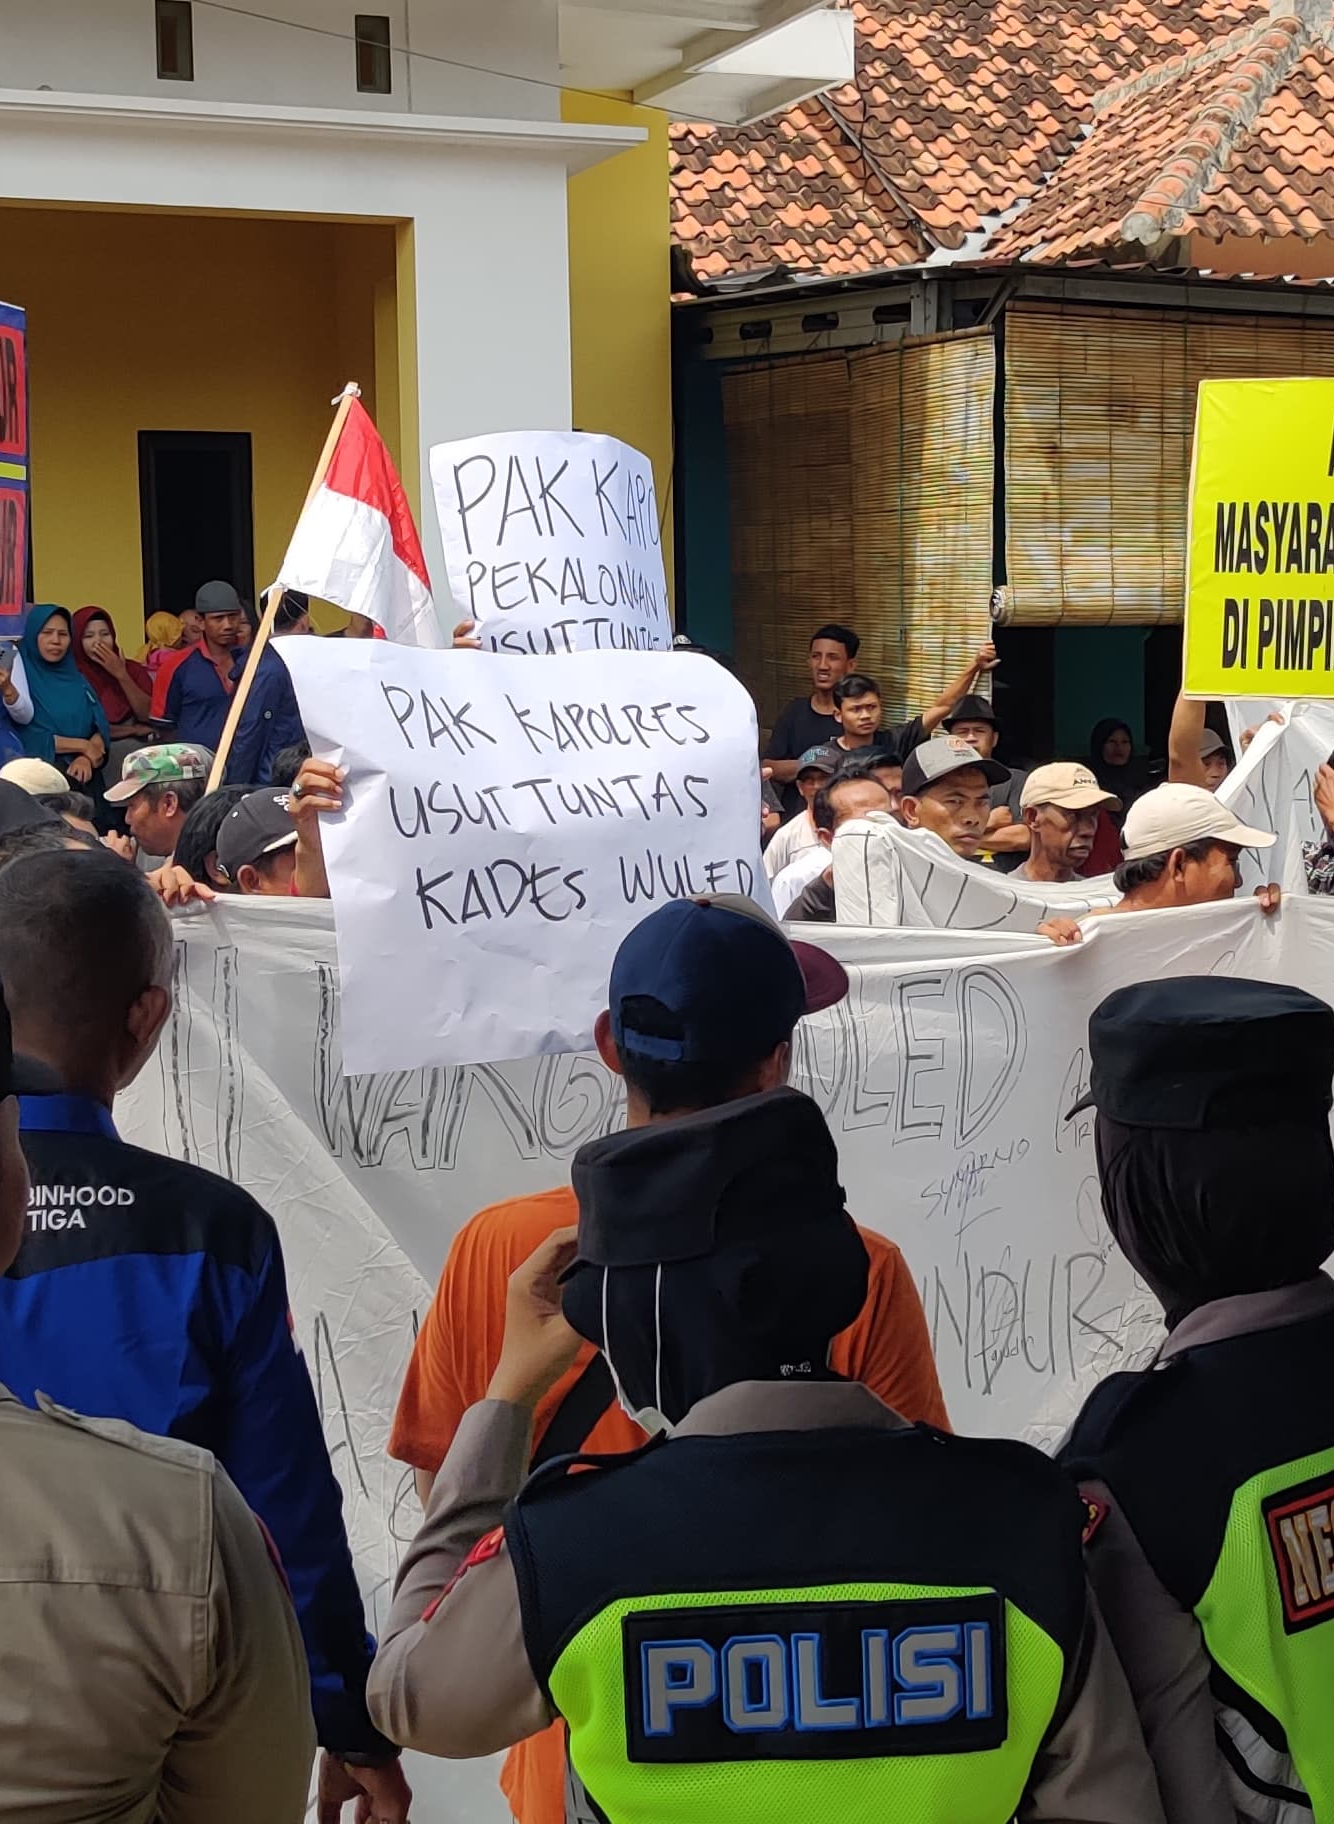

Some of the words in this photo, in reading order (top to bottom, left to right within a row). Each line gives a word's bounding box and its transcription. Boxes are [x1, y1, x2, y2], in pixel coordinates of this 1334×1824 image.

[453, 454, 585, 555] PAK
[1222, 597, 1249, 669] DI
[380, 680, 496, 755] PAK
[505, 693, 711, 755] KAPOLRES
[388, 783, 511, 840] USUT
[514, 773, 710, 825] TUNTAS
[414, 858, 588, 930] KADES
[619, 849, 755, 905] WULED
[27, 1208, 87, 1232] TIGA
[641, 1621, 995, 1738] POLISI
